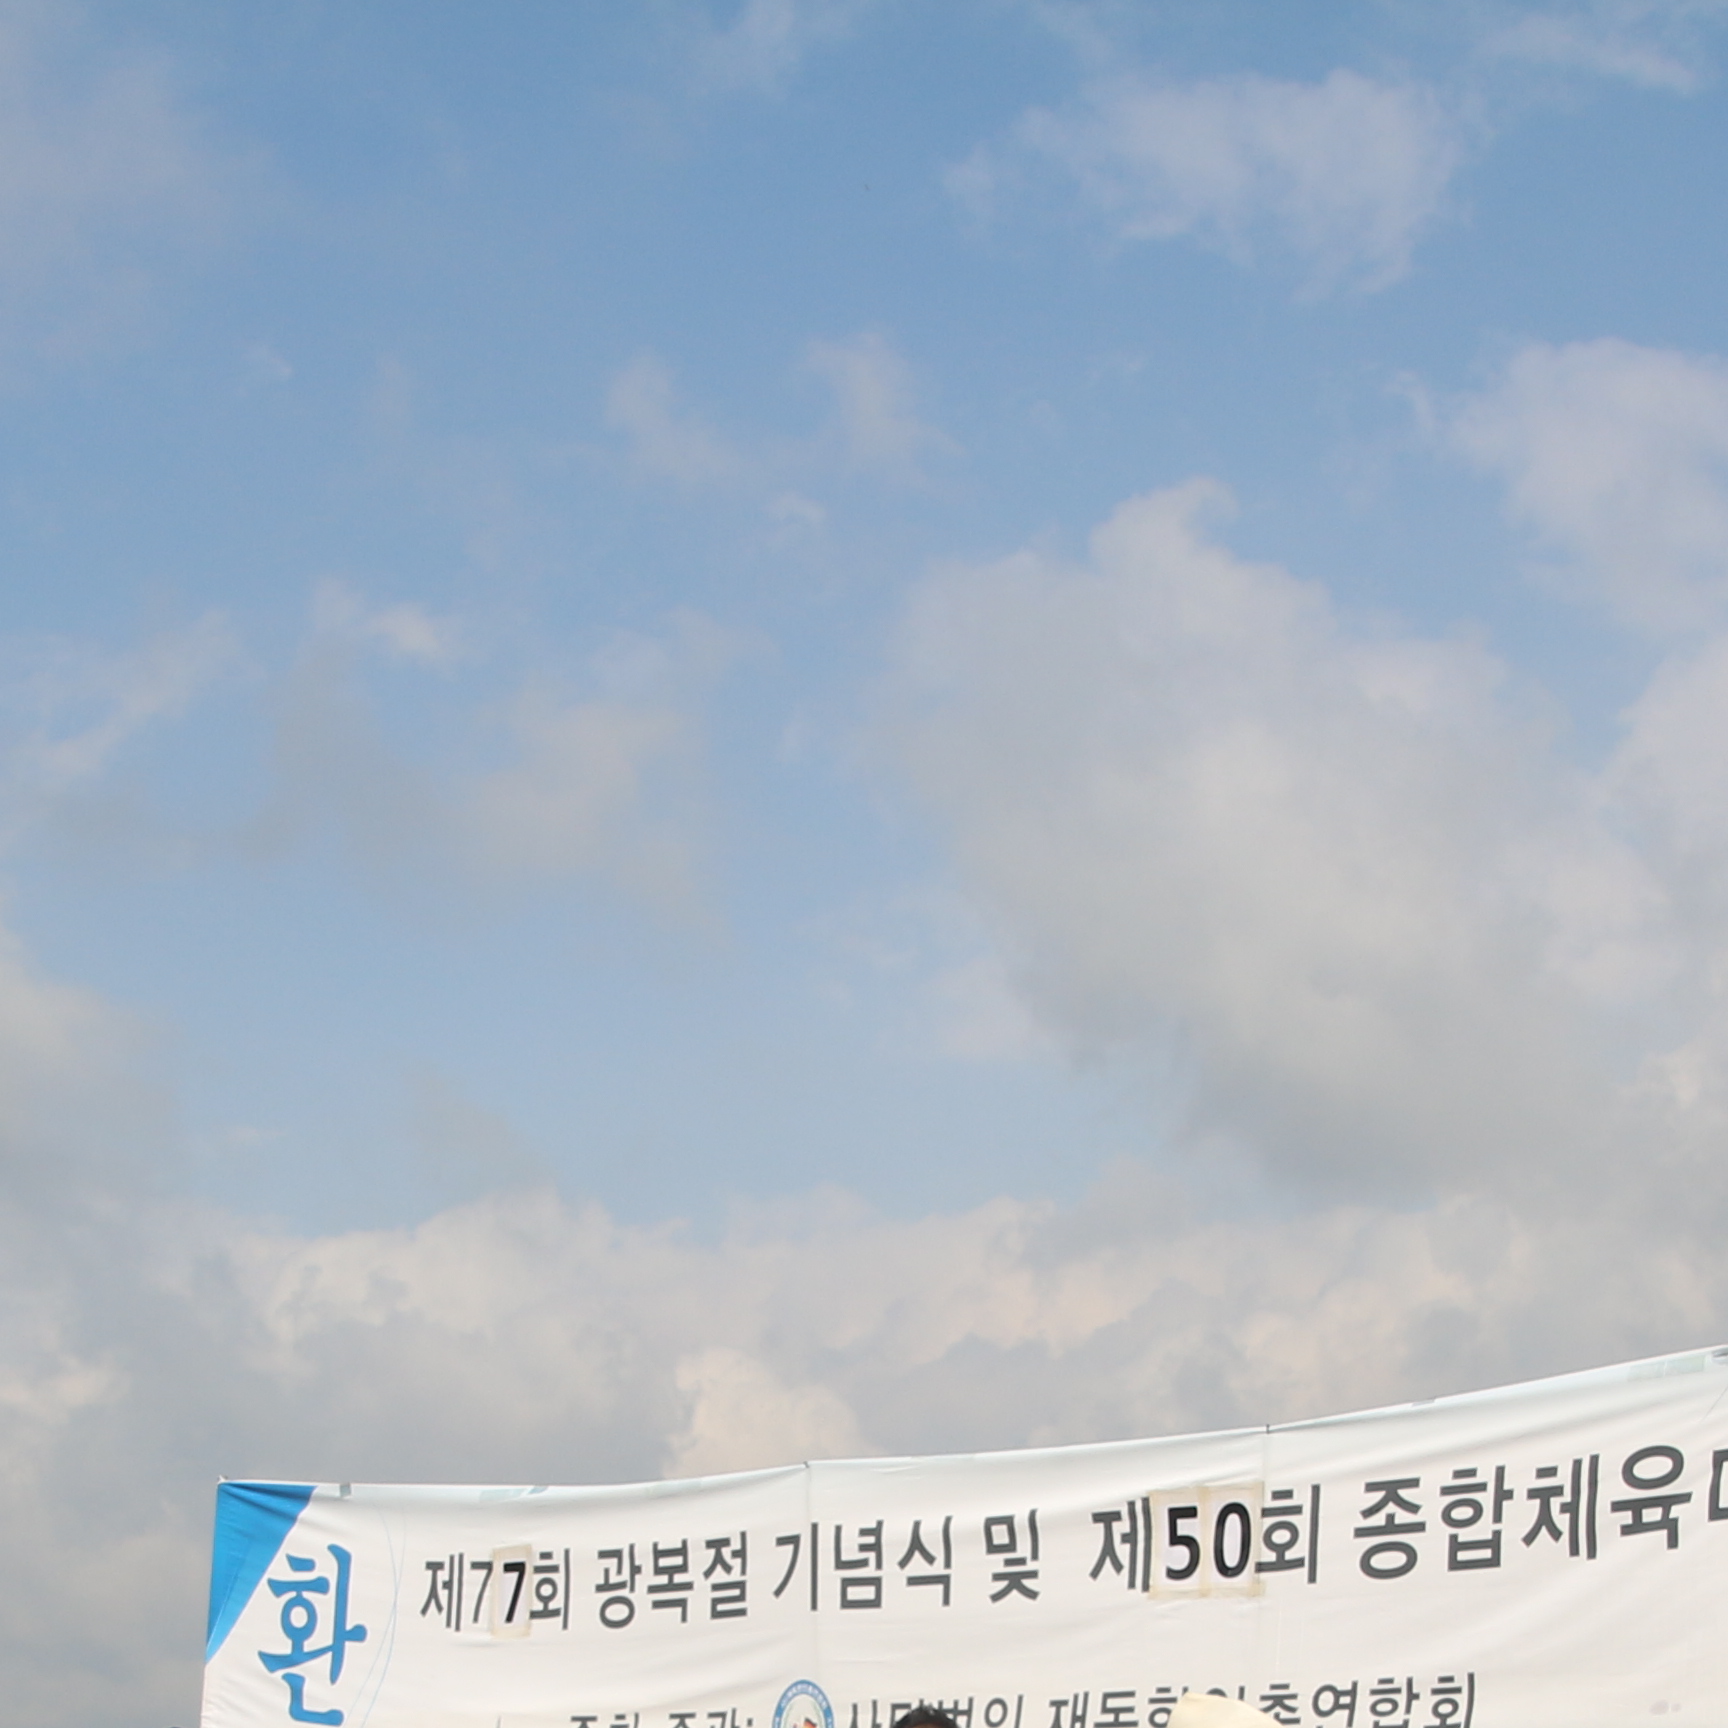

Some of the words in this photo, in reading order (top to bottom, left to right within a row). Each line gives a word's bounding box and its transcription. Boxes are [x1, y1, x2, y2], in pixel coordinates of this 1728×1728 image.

[257, 1541, 367, 1726] 환
[420, 1546, 571, 1632] 제77회
[594, 1540, 748, 1630] 광복절
[773, 1515, 953, 1612] 기념식
[983, 1508, 1041, 1603] 및
[1089, 1483, 1322, 1593] 제50회
